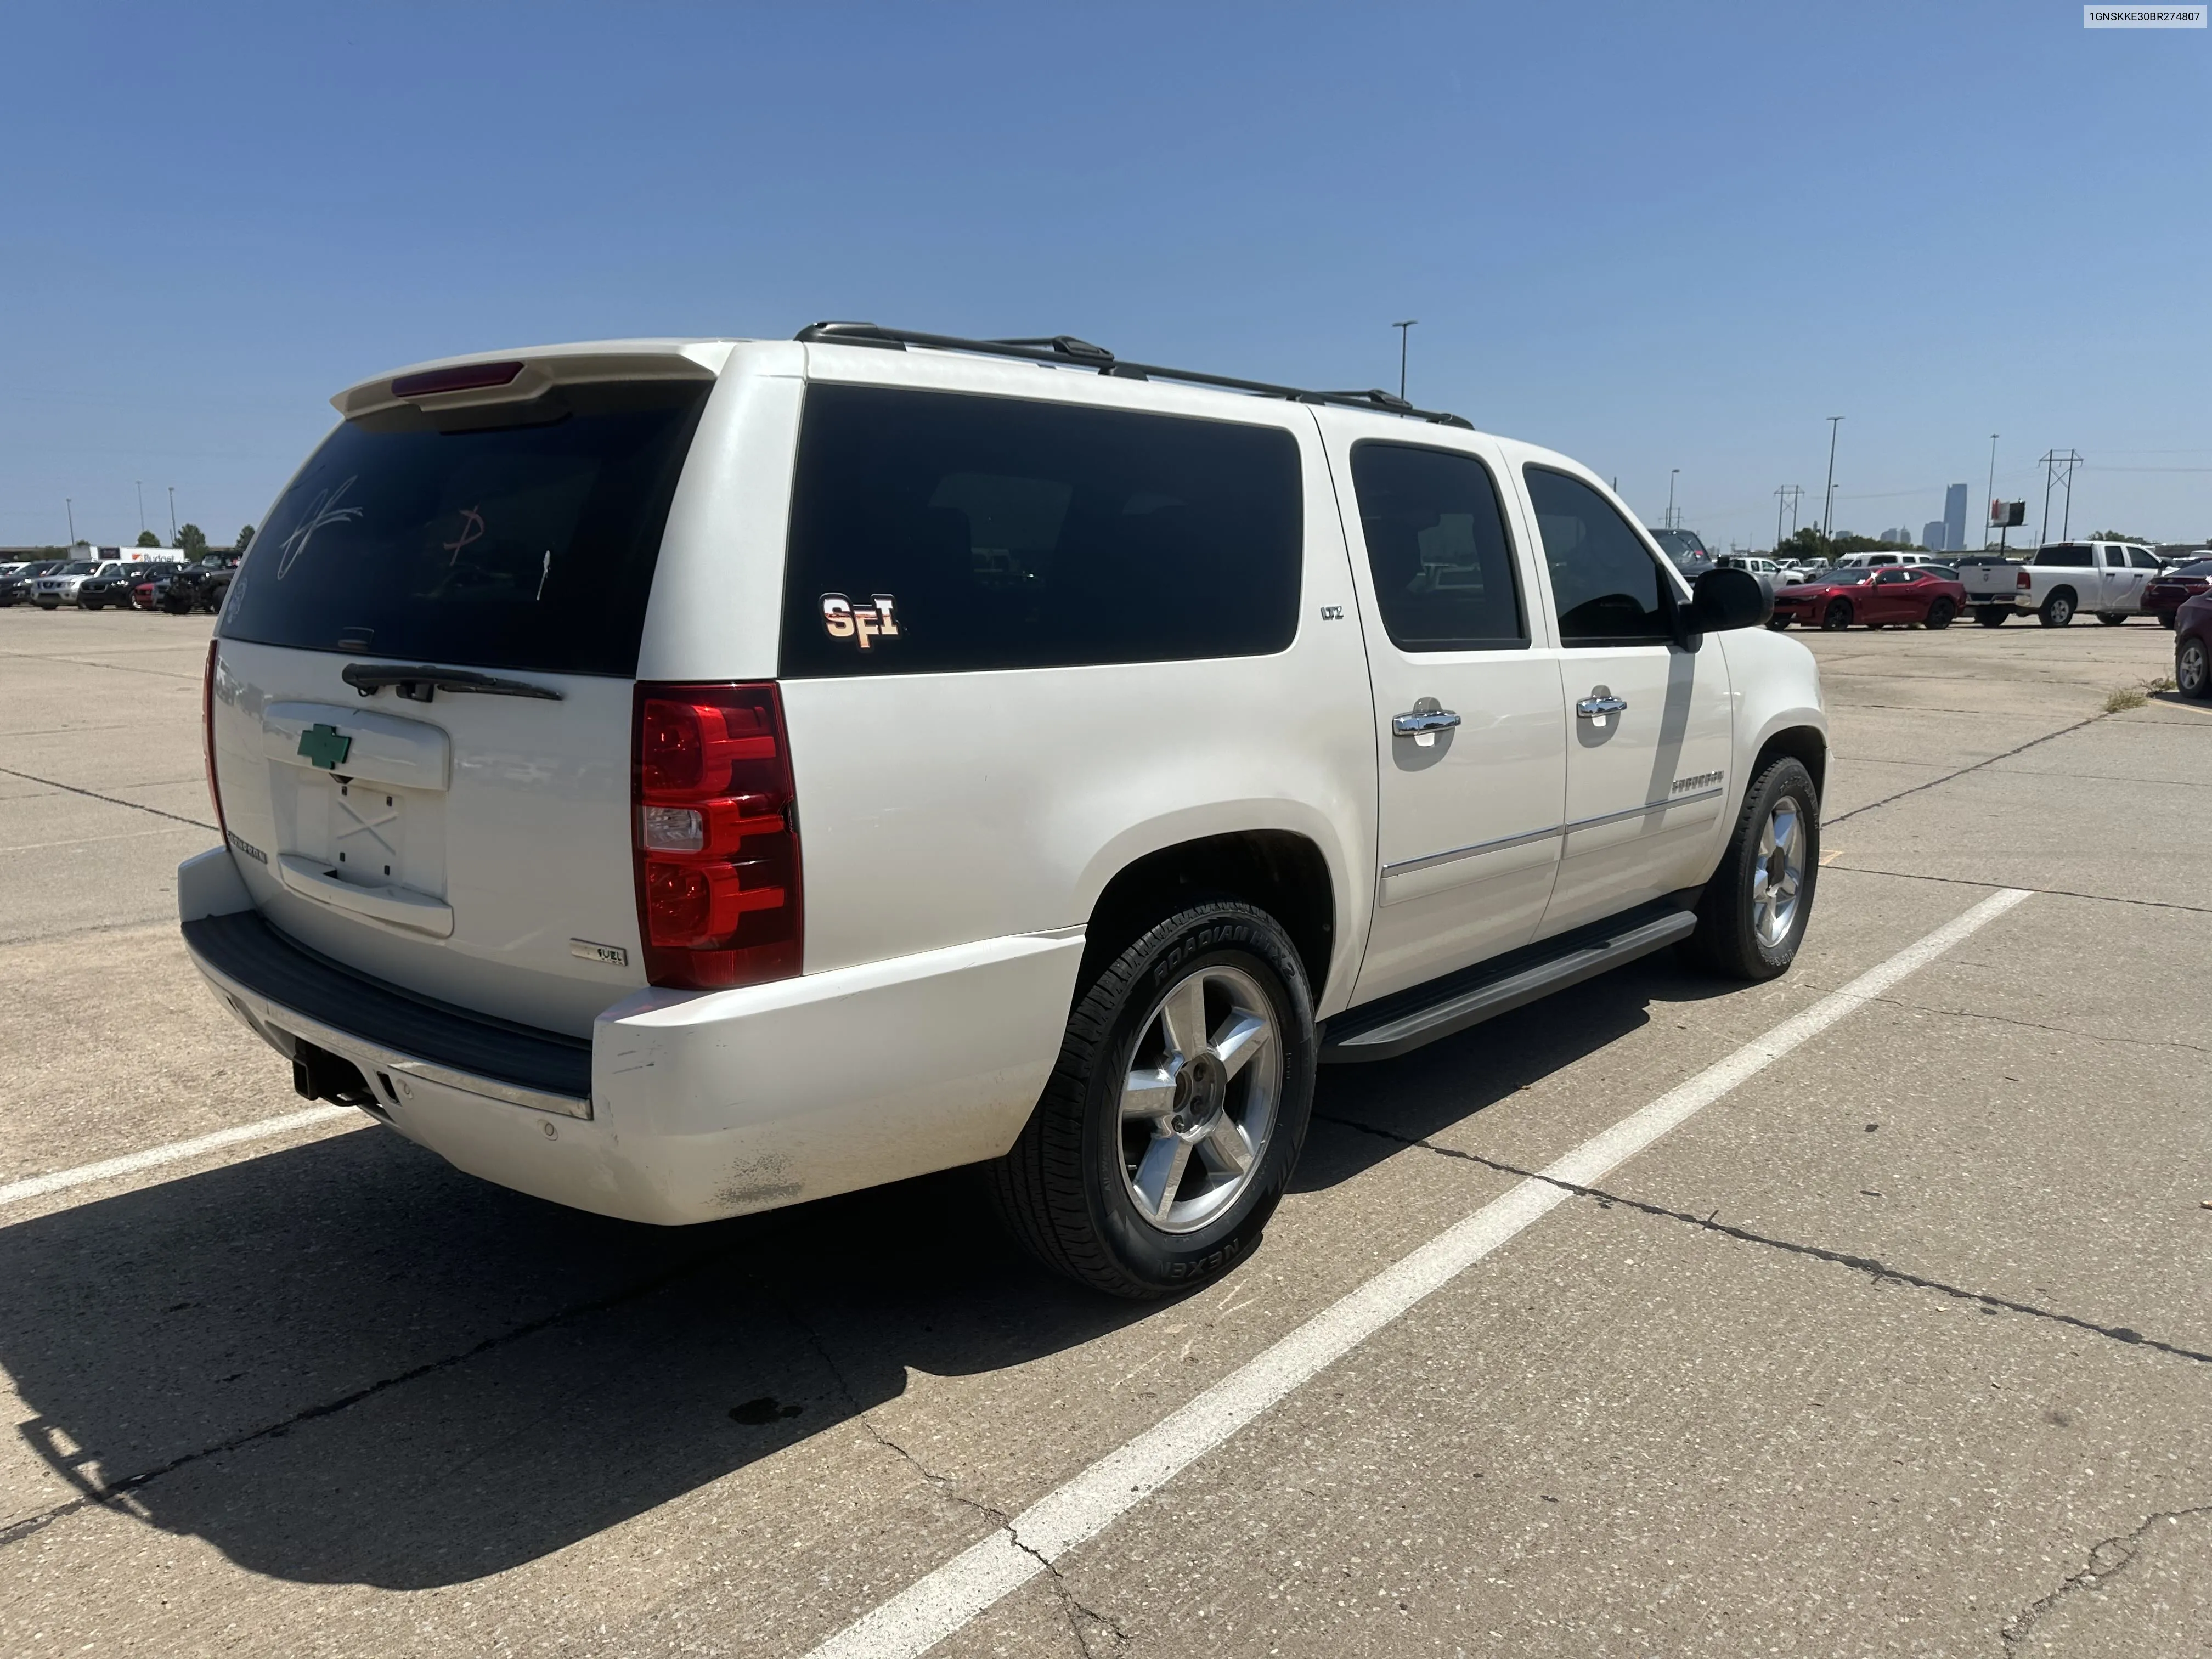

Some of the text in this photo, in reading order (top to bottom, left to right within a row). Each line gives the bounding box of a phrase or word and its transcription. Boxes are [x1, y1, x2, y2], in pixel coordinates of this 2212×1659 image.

[823, 597, 899, 648] SFI
[1321, 606, 1344, 621] LTZ
[1158, 1238, 1240, 1279] NEXEN
